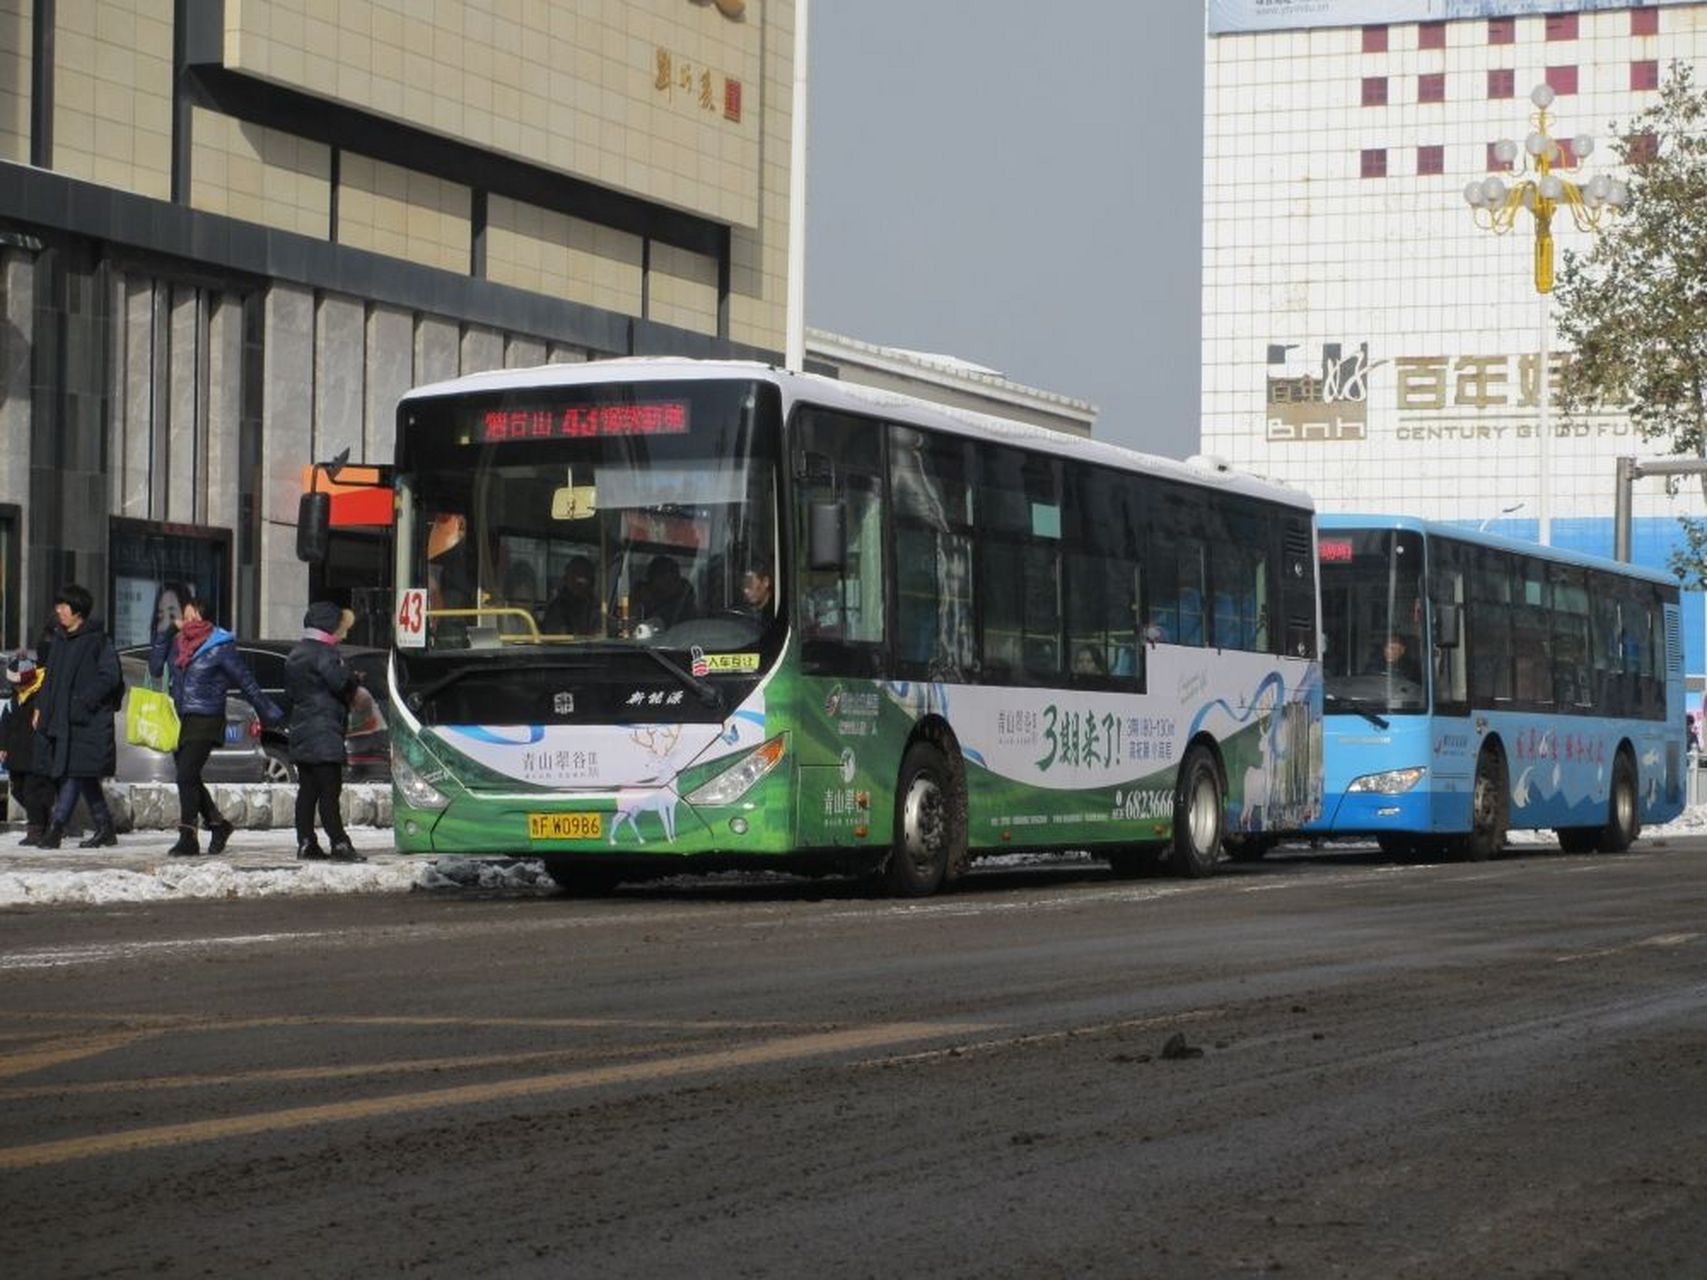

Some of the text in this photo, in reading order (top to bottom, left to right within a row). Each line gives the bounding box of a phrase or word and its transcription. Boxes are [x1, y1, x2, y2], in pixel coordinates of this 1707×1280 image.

[1396, 425, 1508, 440] CENTURY
[399, 591, 422, 633] 43
[1125, 789, 1176, 820] 6823666
[552, 815, 600, 836] W0986
